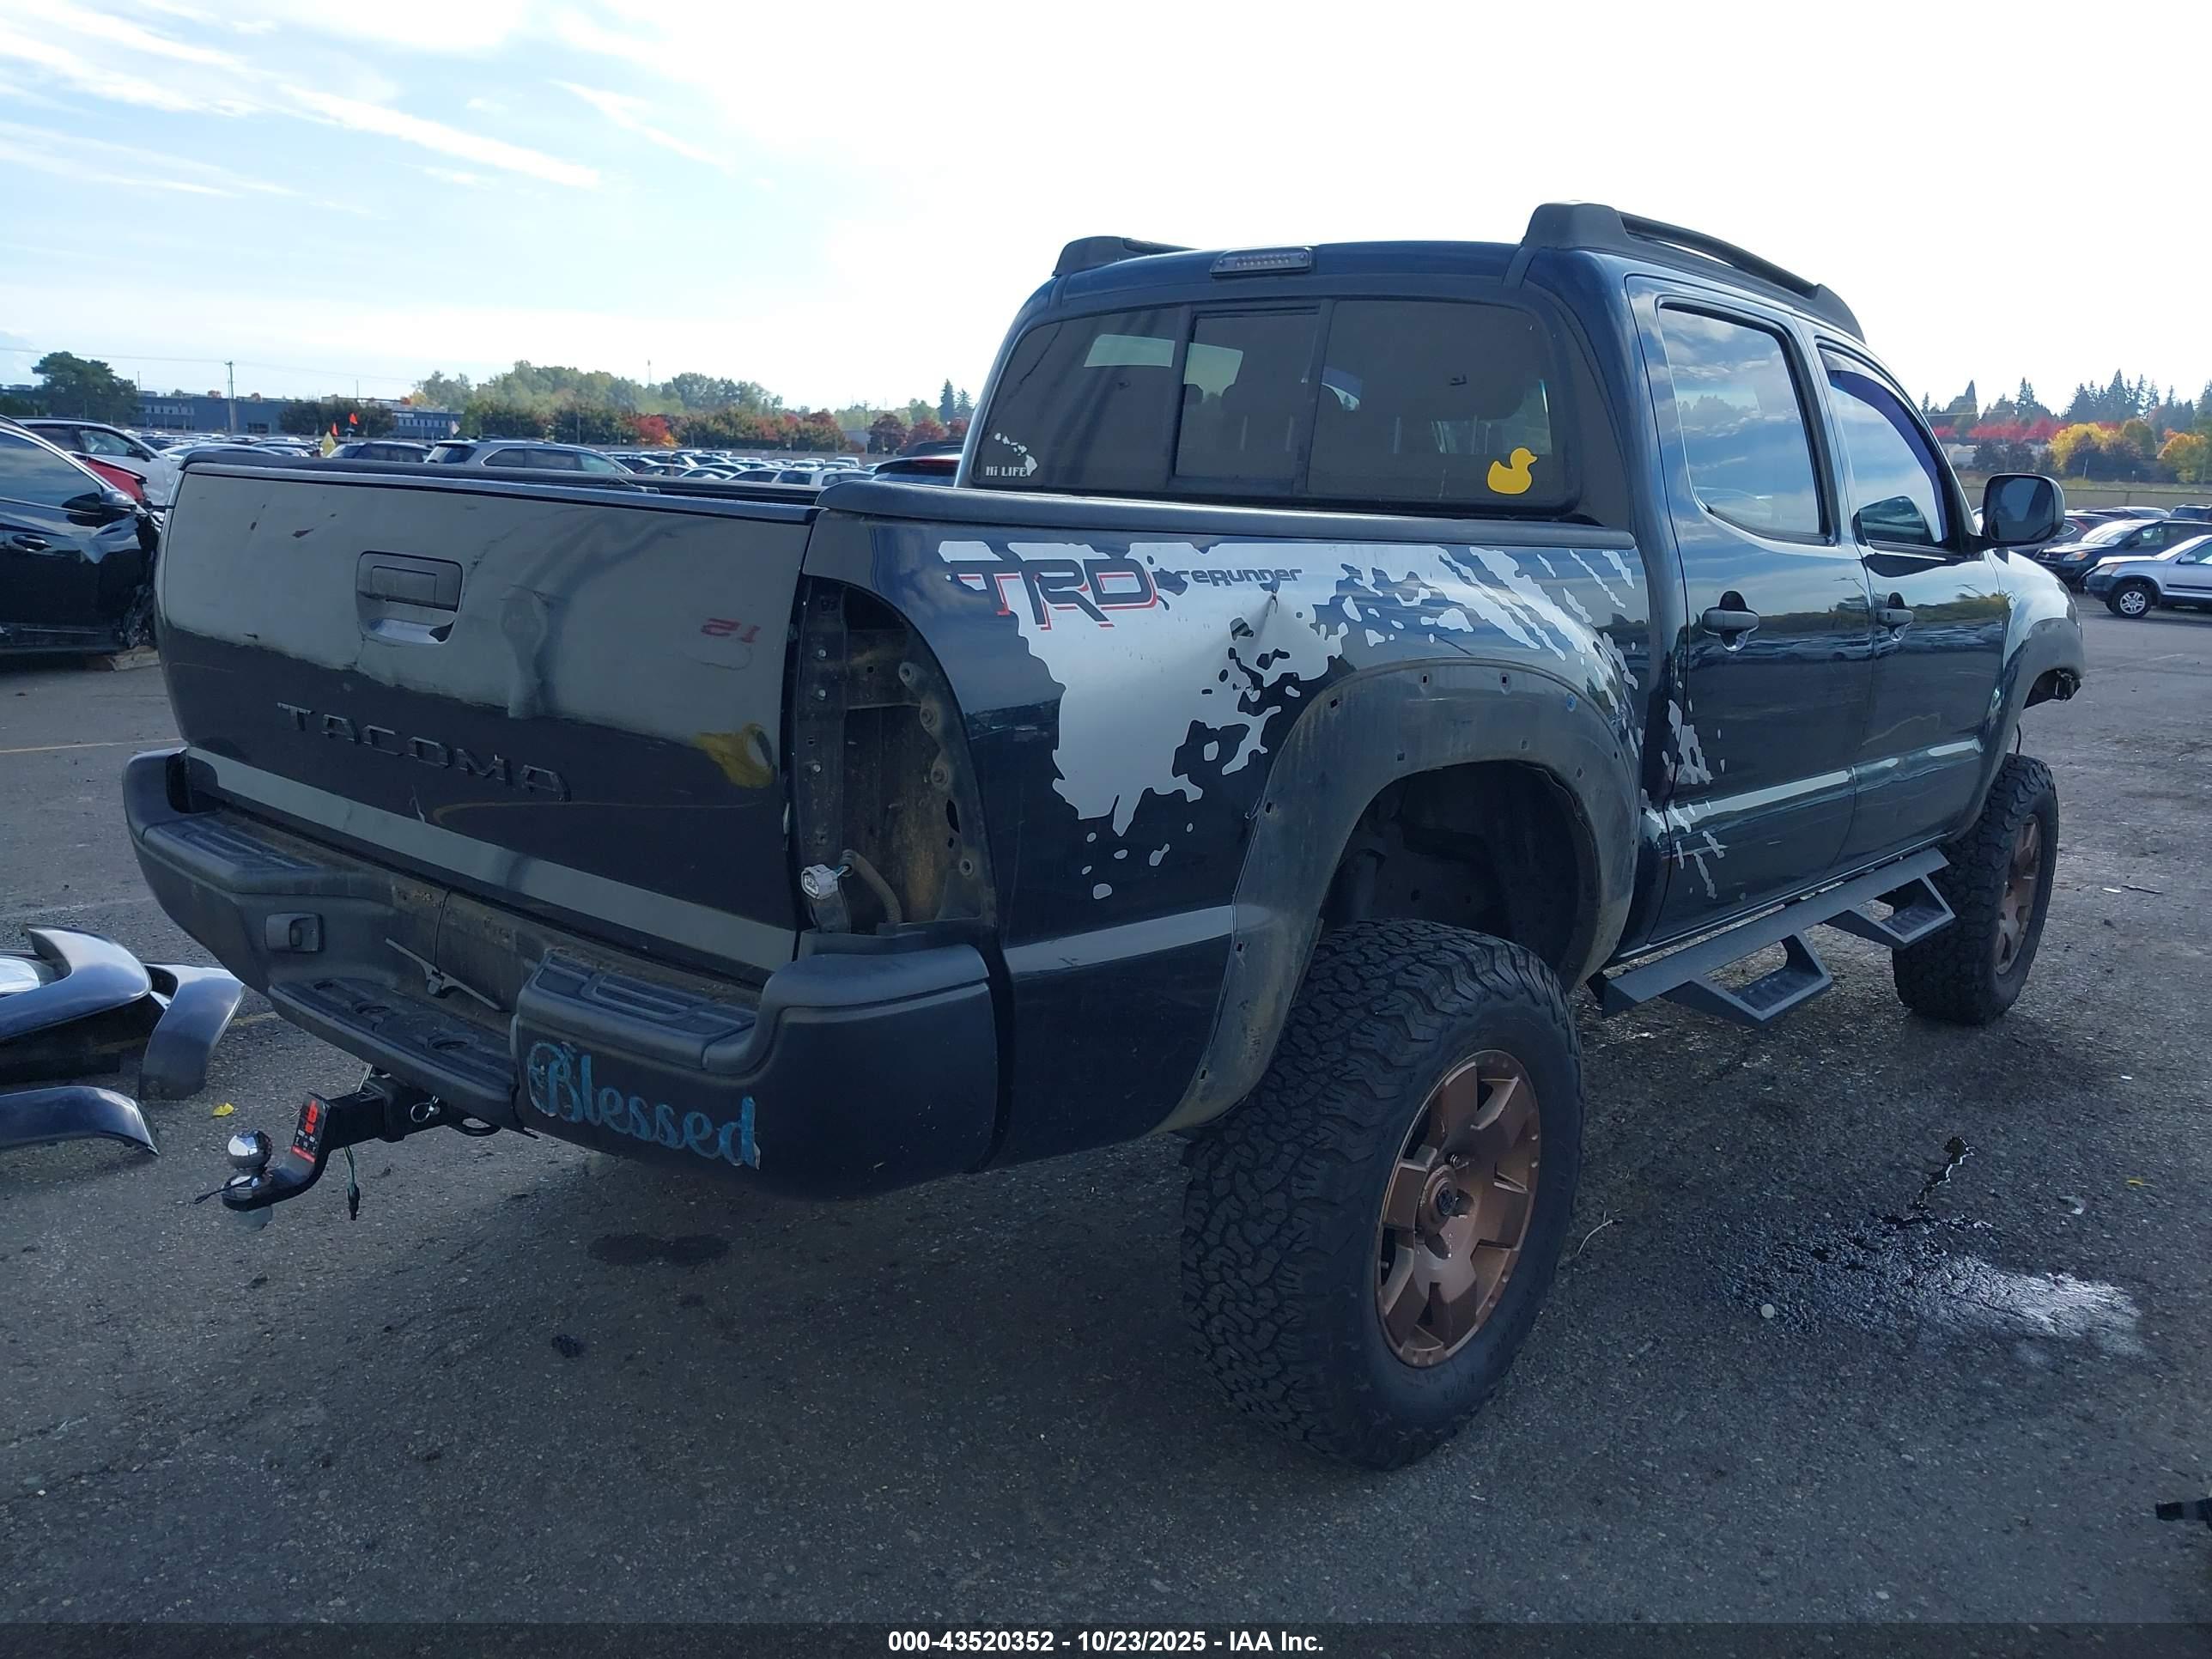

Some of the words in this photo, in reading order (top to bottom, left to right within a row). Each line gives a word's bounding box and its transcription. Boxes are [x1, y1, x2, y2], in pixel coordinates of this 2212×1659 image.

[1000, 466, 1028, 477] LIFE
[945, 558, 1157, 631] TRD
[276, 702, 572, 802] TACOMA
[526, 1041, 761, 1170] Blessed
